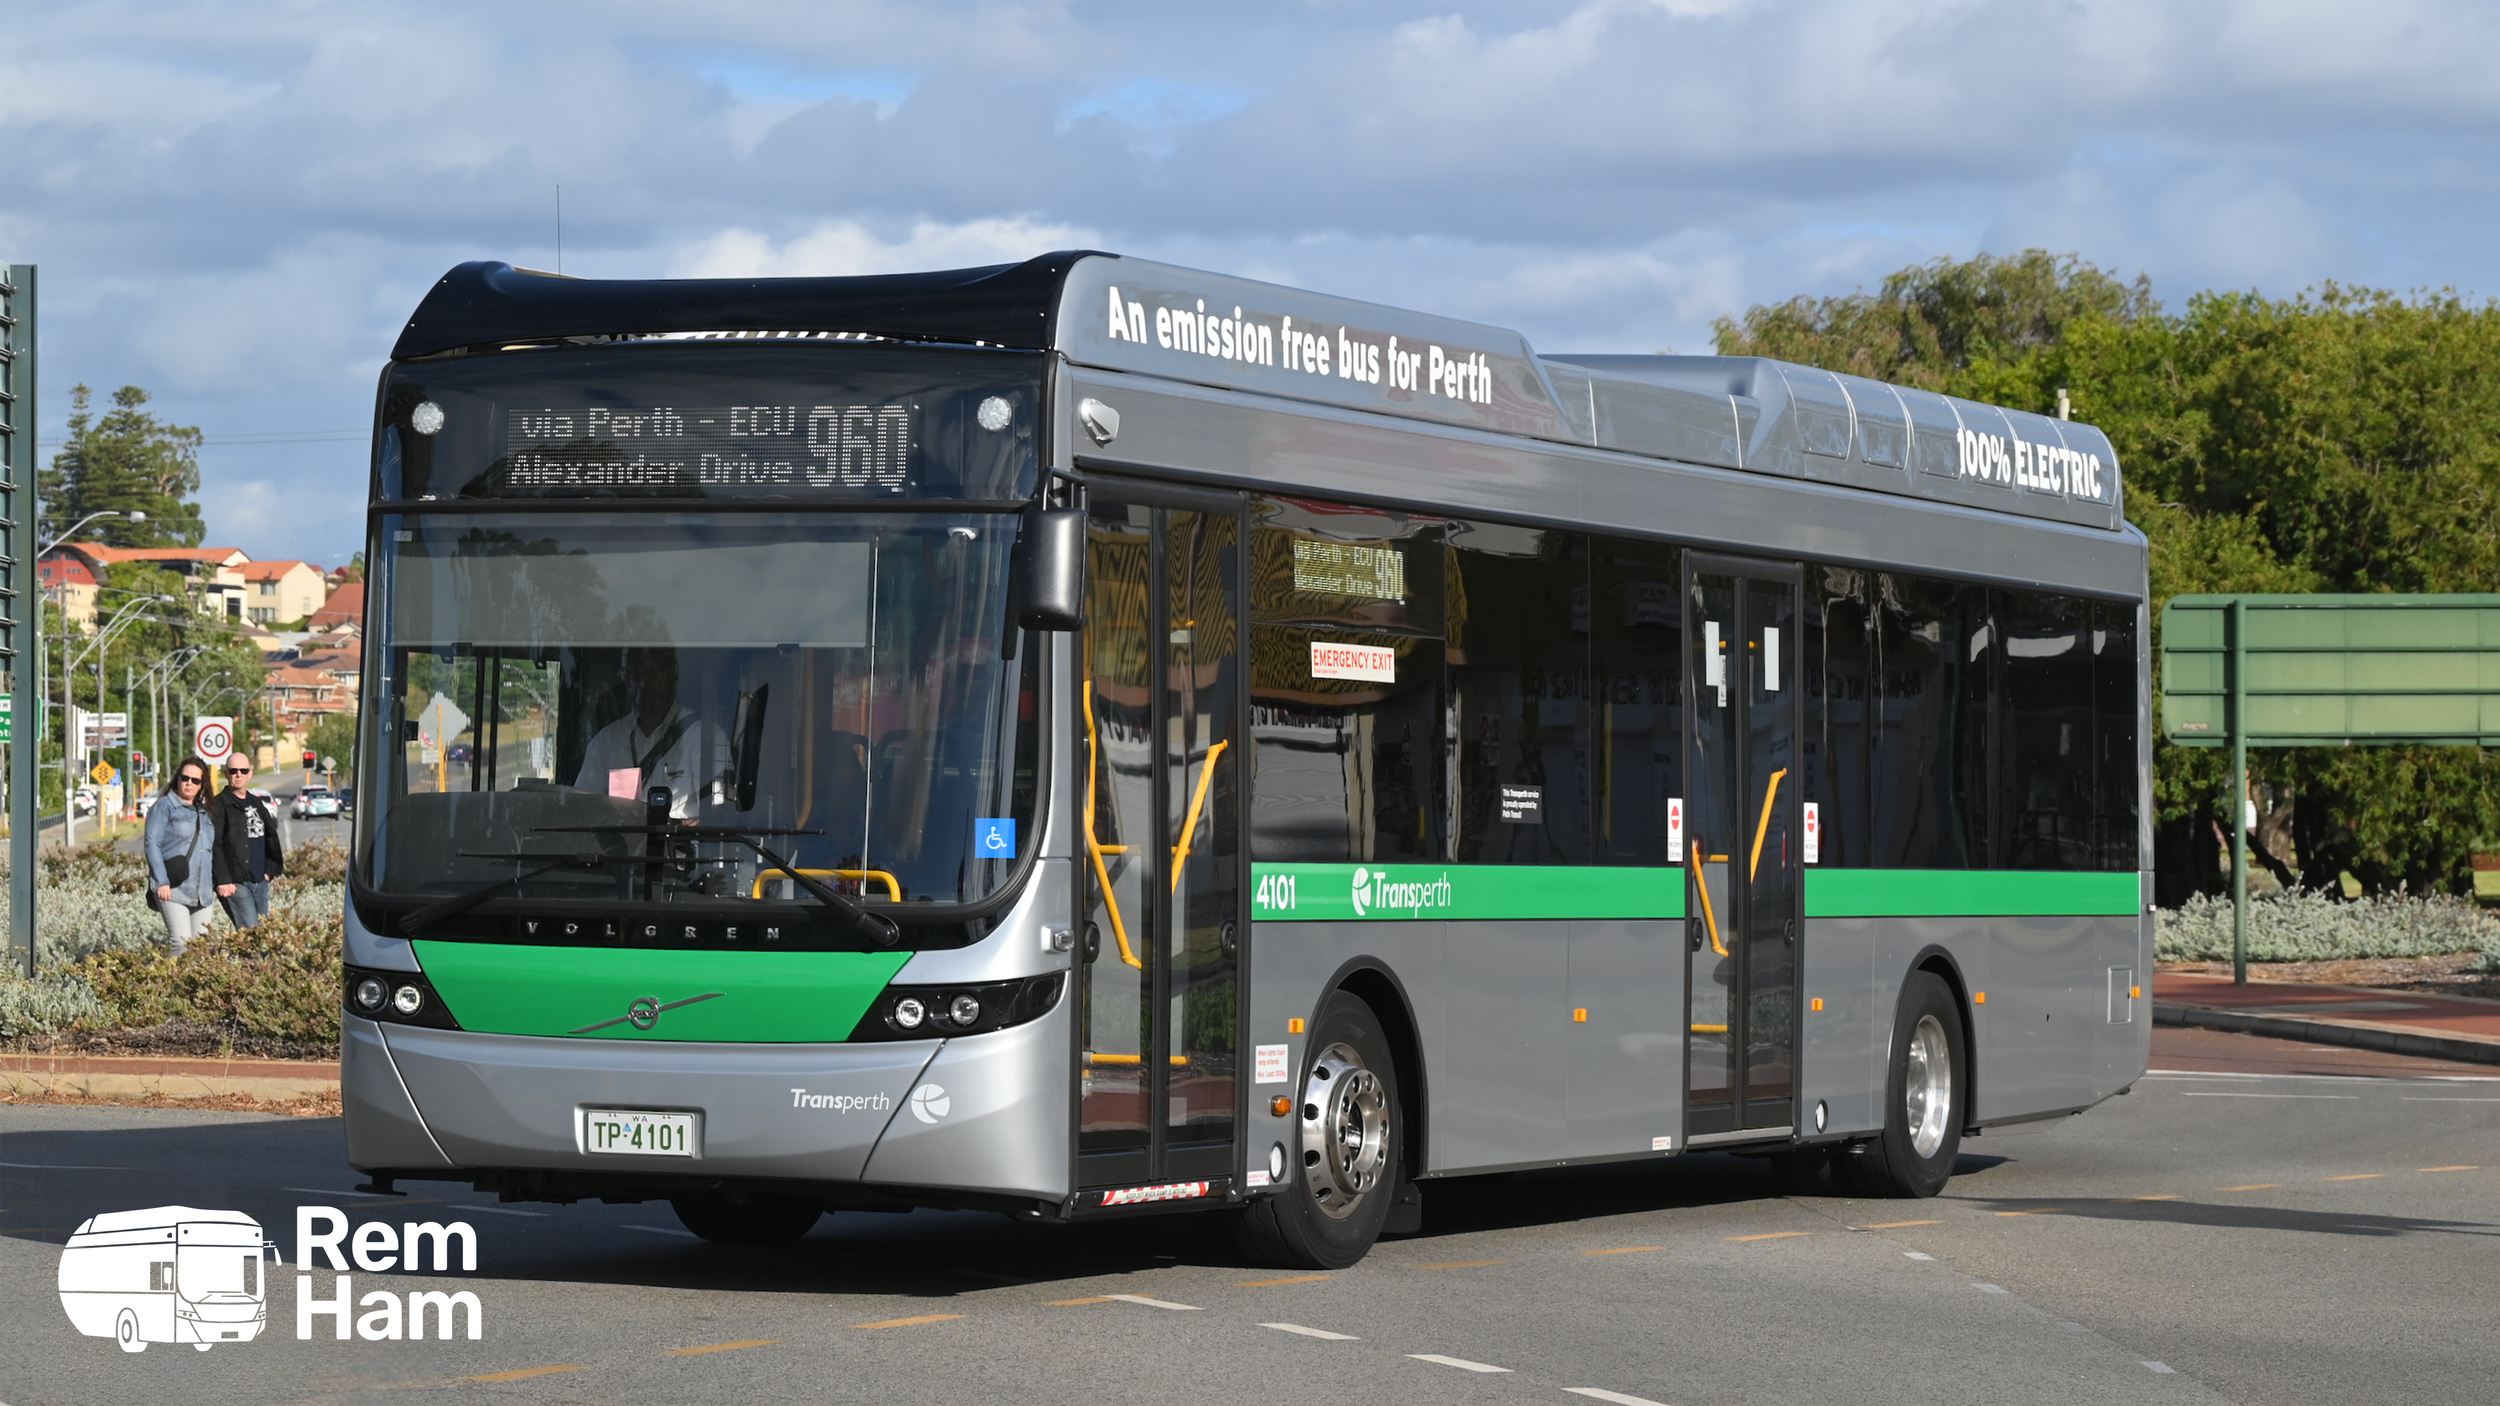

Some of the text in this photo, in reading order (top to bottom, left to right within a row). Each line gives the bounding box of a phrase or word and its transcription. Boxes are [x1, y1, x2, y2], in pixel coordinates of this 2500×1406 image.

[1108, 286, 1492, 404] An emission free bus for Perth
[522, 408, 573, 438] via
[589, 407, 683, 438] Perth
[730, 406, 795, 436] ECU
[806, 405, 908, 487] 960
[511, 453, 793, 485] Alexander Drive
[1956, 428, 2101, 498] 100% ELECTRIC
[1375, 549, 1403, 600] 960
[1313, 648, 1393, 670] EMERGENCY EXIT
[203, 733, 225, 748] 60
[1256, 874, 1296, 910] 4101
[1373, 872, 1451, 918] Transperth
[527, 922, 780, 939] VOLGREN
[790, 1088, 890, 1115] Transperth
[632, 1115, 648, 1123] WA
[594, 1122, 684, 1151] TP 4101
